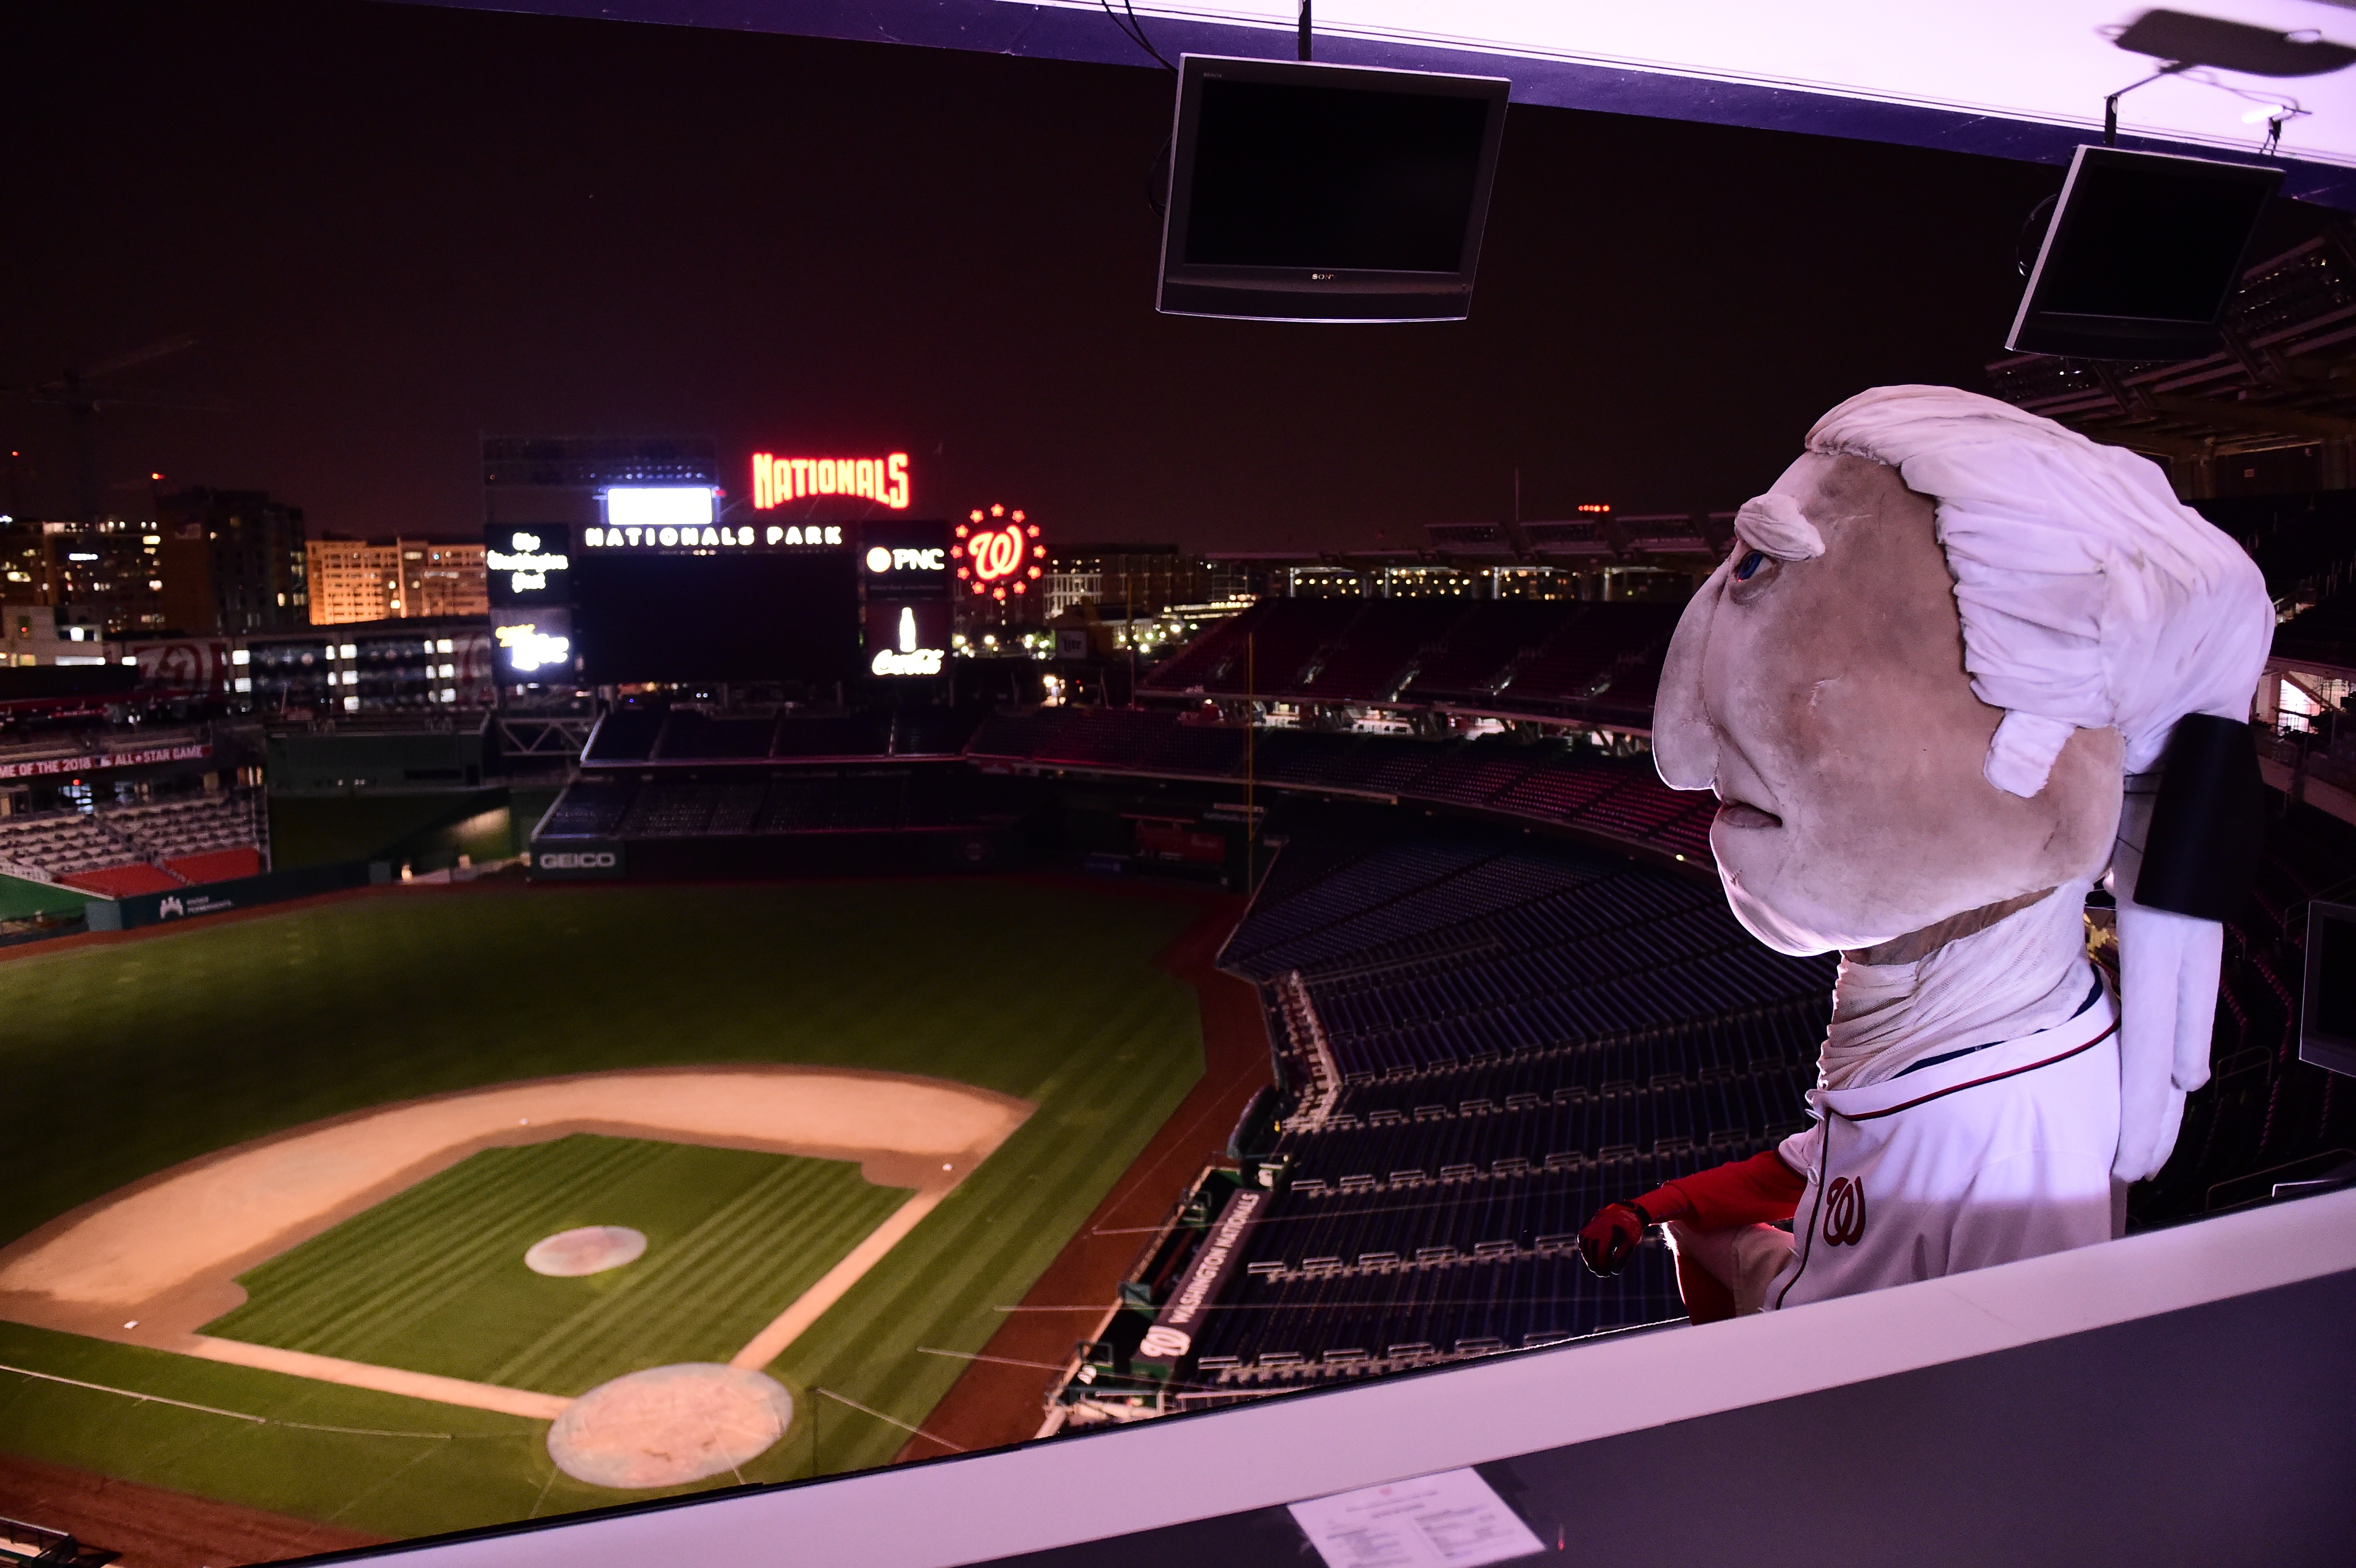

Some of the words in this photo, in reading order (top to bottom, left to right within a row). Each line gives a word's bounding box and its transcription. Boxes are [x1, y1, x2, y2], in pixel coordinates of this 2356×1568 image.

[752, 452, 909, 510] NATIONALS
[585, 527, 755, 546] NATIONALS
[767, 526, 842, 545] PARK
[968, 525, 1023, 580] W
[892, 548, 945, 570] PNC
[19, 763, 33, 776] OF
[38, 760, 58, 774] THE
[63, 757, 91, 772] 2018
[173, 745, 203, 761] GAME
[539, 852, 616, 869] GEICO
[1822, 1176, 1866, 1247] W
[1168, 1246, 1229, 1323] WASHINGTON
[1213, 1193, 1260, 1249] NATIONALS
